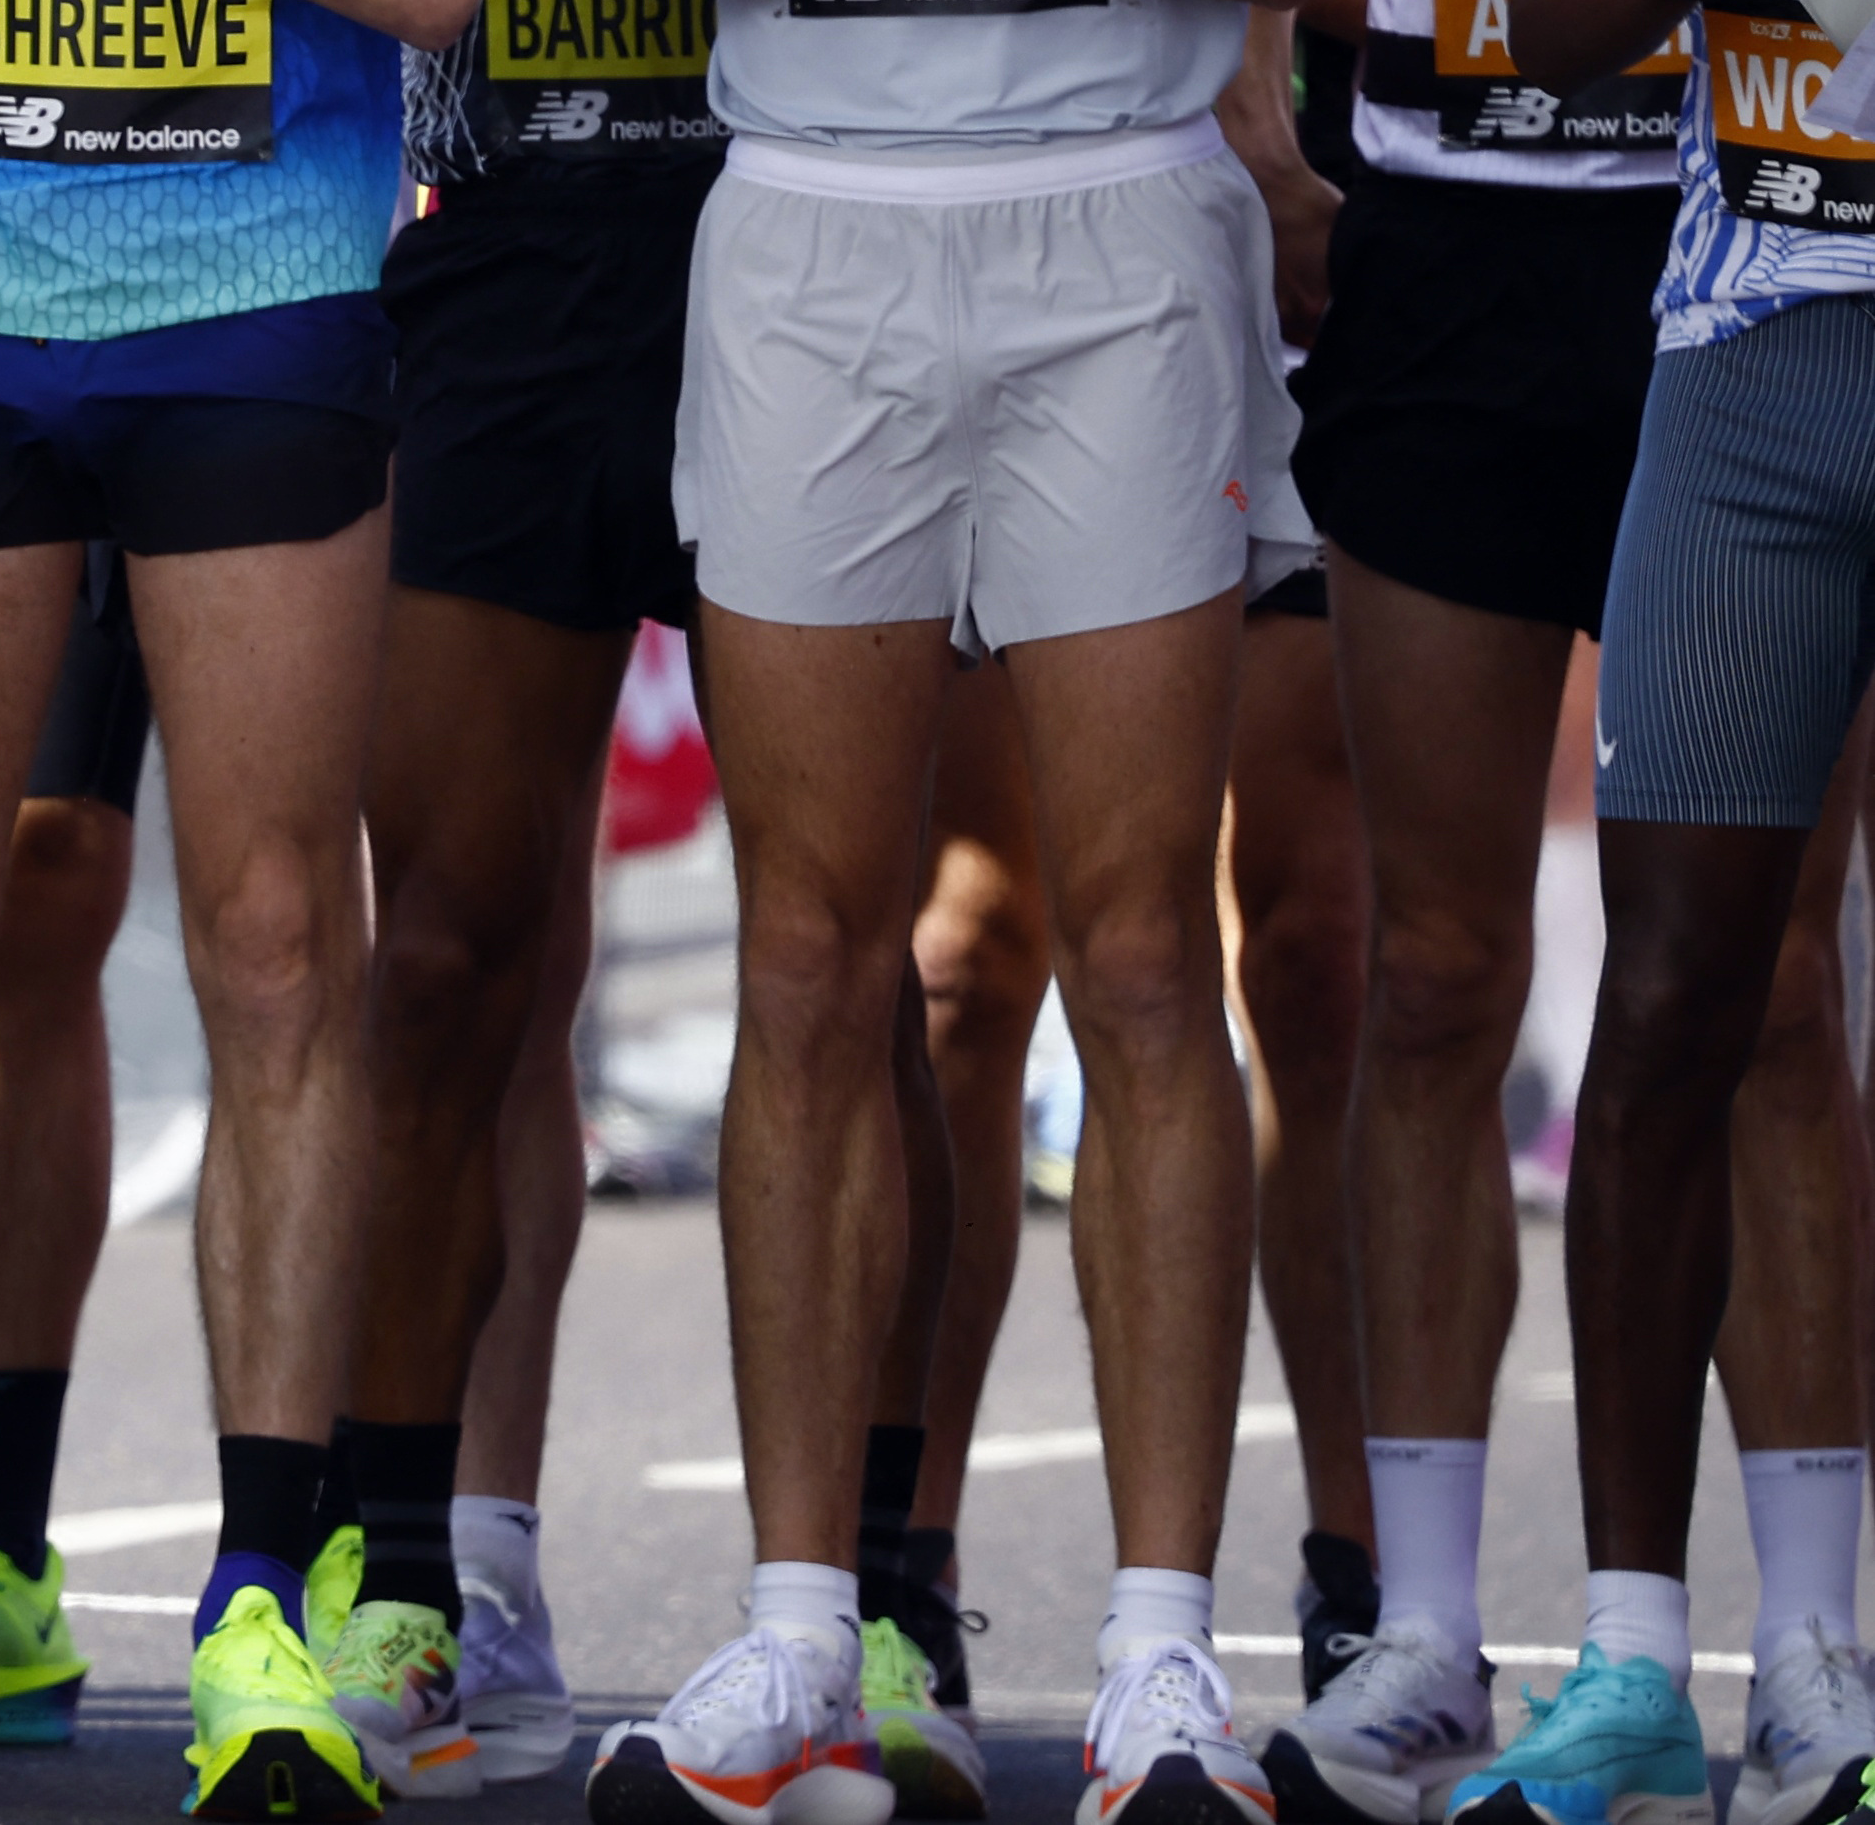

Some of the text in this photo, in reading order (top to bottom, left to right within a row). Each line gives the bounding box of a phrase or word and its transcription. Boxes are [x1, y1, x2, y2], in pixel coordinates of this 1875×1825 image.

[518, 89, 610, 142] NB
[1563, 114, 1621, 139] new
[64, 125, 241, 152] new balance
[610, 121, 665, 141] new
[1744, 159, 1822, 216] NB
[1823, 199, 1875, 224] new
